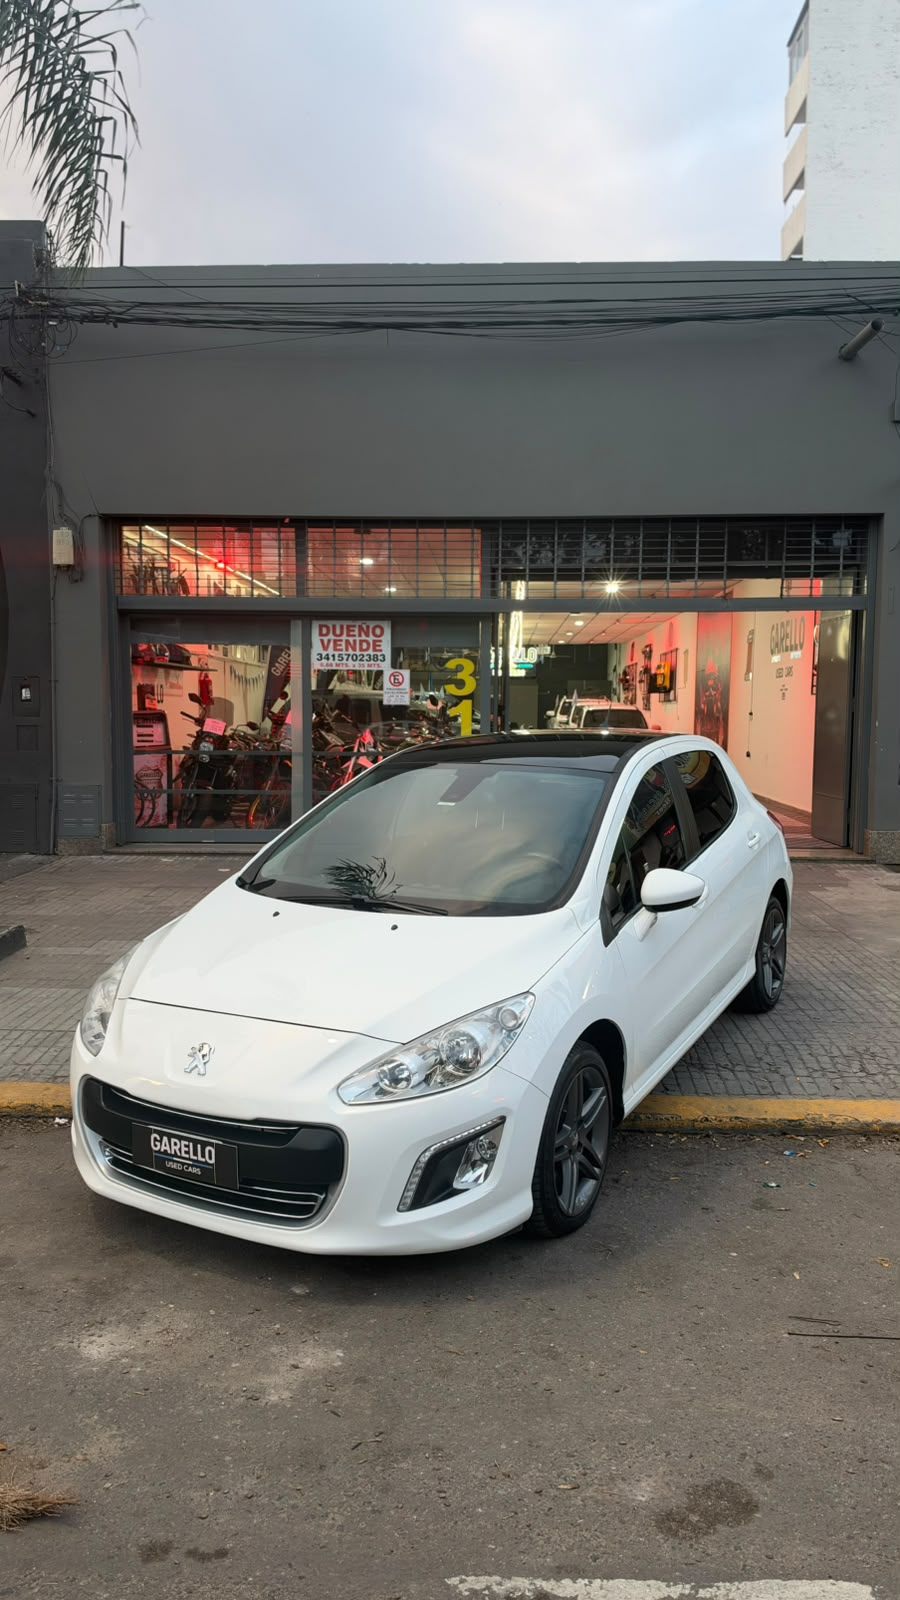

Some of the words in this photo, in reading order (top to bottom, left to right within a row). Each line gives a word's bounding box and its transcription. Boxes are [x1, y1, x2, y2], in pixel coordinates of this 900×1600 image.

[318, 622, 384, 638] DUEÑO
[771, 617, 805, 655] GARELLO
[320, 639, 383, 652] VENDE
[316, 653, 386, 662] 3415702383
[150, 1133, 215, 1163] GARELLO
[165, 1161, 182, 1170] USED
[184, 1165, 201, 1175] CARS
